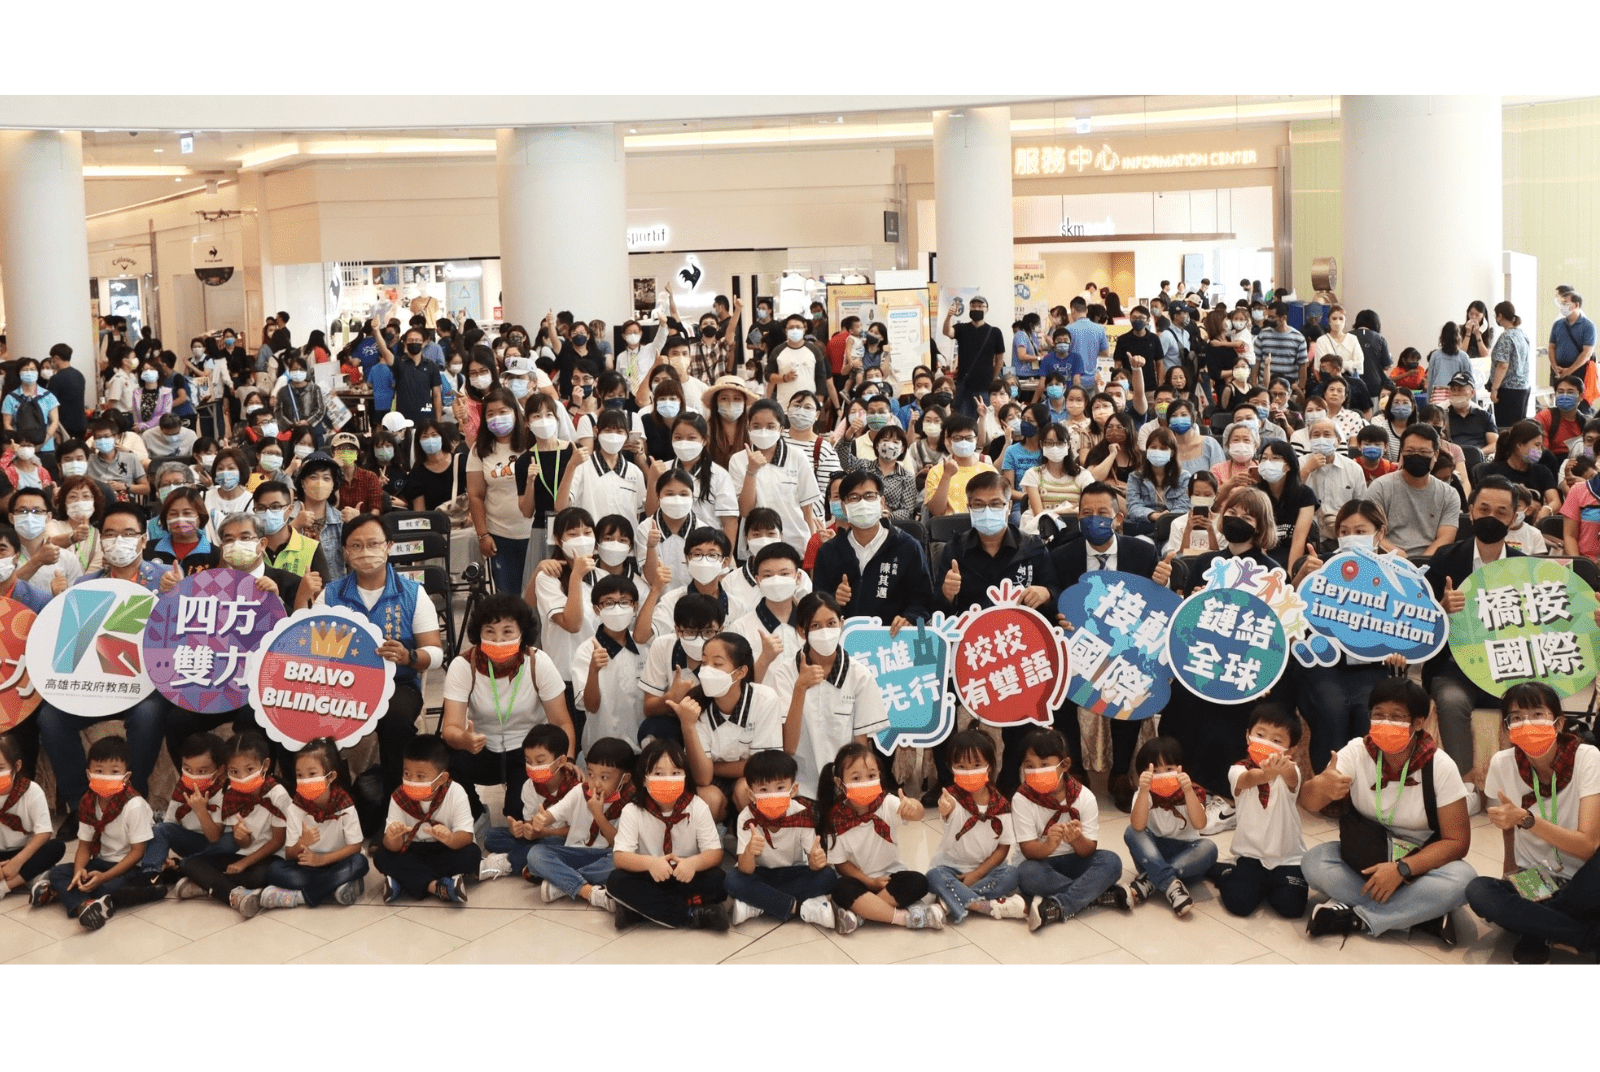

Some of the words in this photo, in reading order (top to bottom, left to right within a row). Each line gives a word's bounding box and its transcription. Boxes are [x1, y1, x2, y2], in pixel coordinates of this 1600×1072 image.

[1014, 144, 1120, 175] 服務中心
[1121, 152, 1208, 170] INFORMATION
[1209, 149, 1258, 166] CENTER
[627, 228, 665, 245] sportif
[176, 594, 261, 637] 四方
[1311, 574, 1389, 612] Beyond
[1392, 600, 1443, 623] your
[1311, 598, 1435, 645] imagination
[1474, 580, 1573, 631] 橋接
[964, 623, 1027, 671] 校校
[1197, 597, 1276, 650] 鏈結
[170, 645, 254, 687] 雙力
[284, 660, 355, 688] BRAVO
[961, 649, 1053, 710] 有雙語
[1069, 626, 1154, 712] 國際
[1183, 641, 1262, 692] 全球
[1484, 631, 1584, 682] 國際
[44, 678, 141, 695] 高雄市政府教育局
[880, 672, 940, 711] 先行
